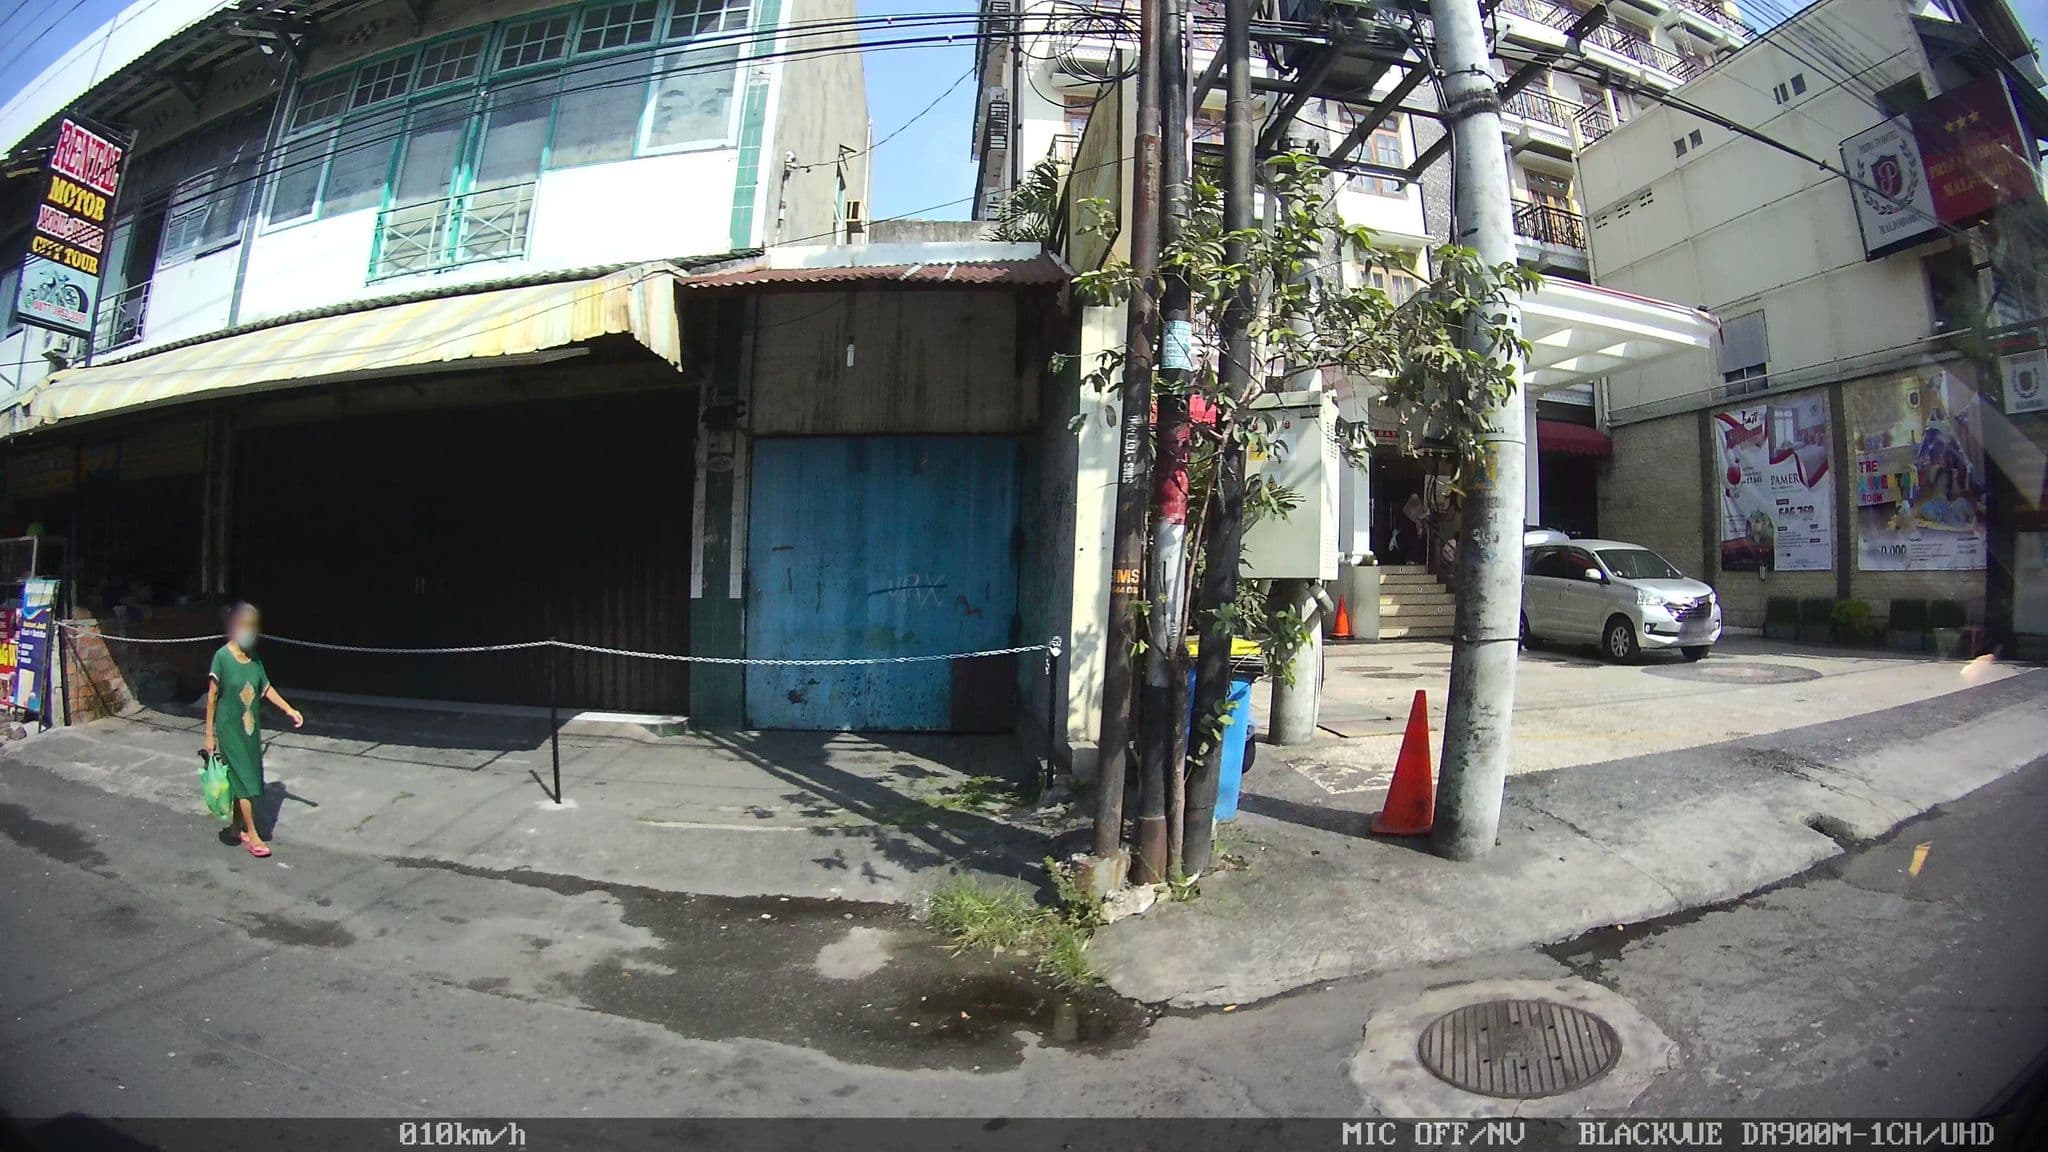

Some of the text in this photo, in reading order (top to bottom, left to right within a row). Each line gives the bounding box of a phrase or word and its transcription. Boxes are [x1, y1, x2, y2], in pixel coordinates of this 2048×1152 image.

[51, 118, 122, 196] RENTAL
[48, 177, 105, 222] MOTOR
[65, 247, 98, 274] TOUR
